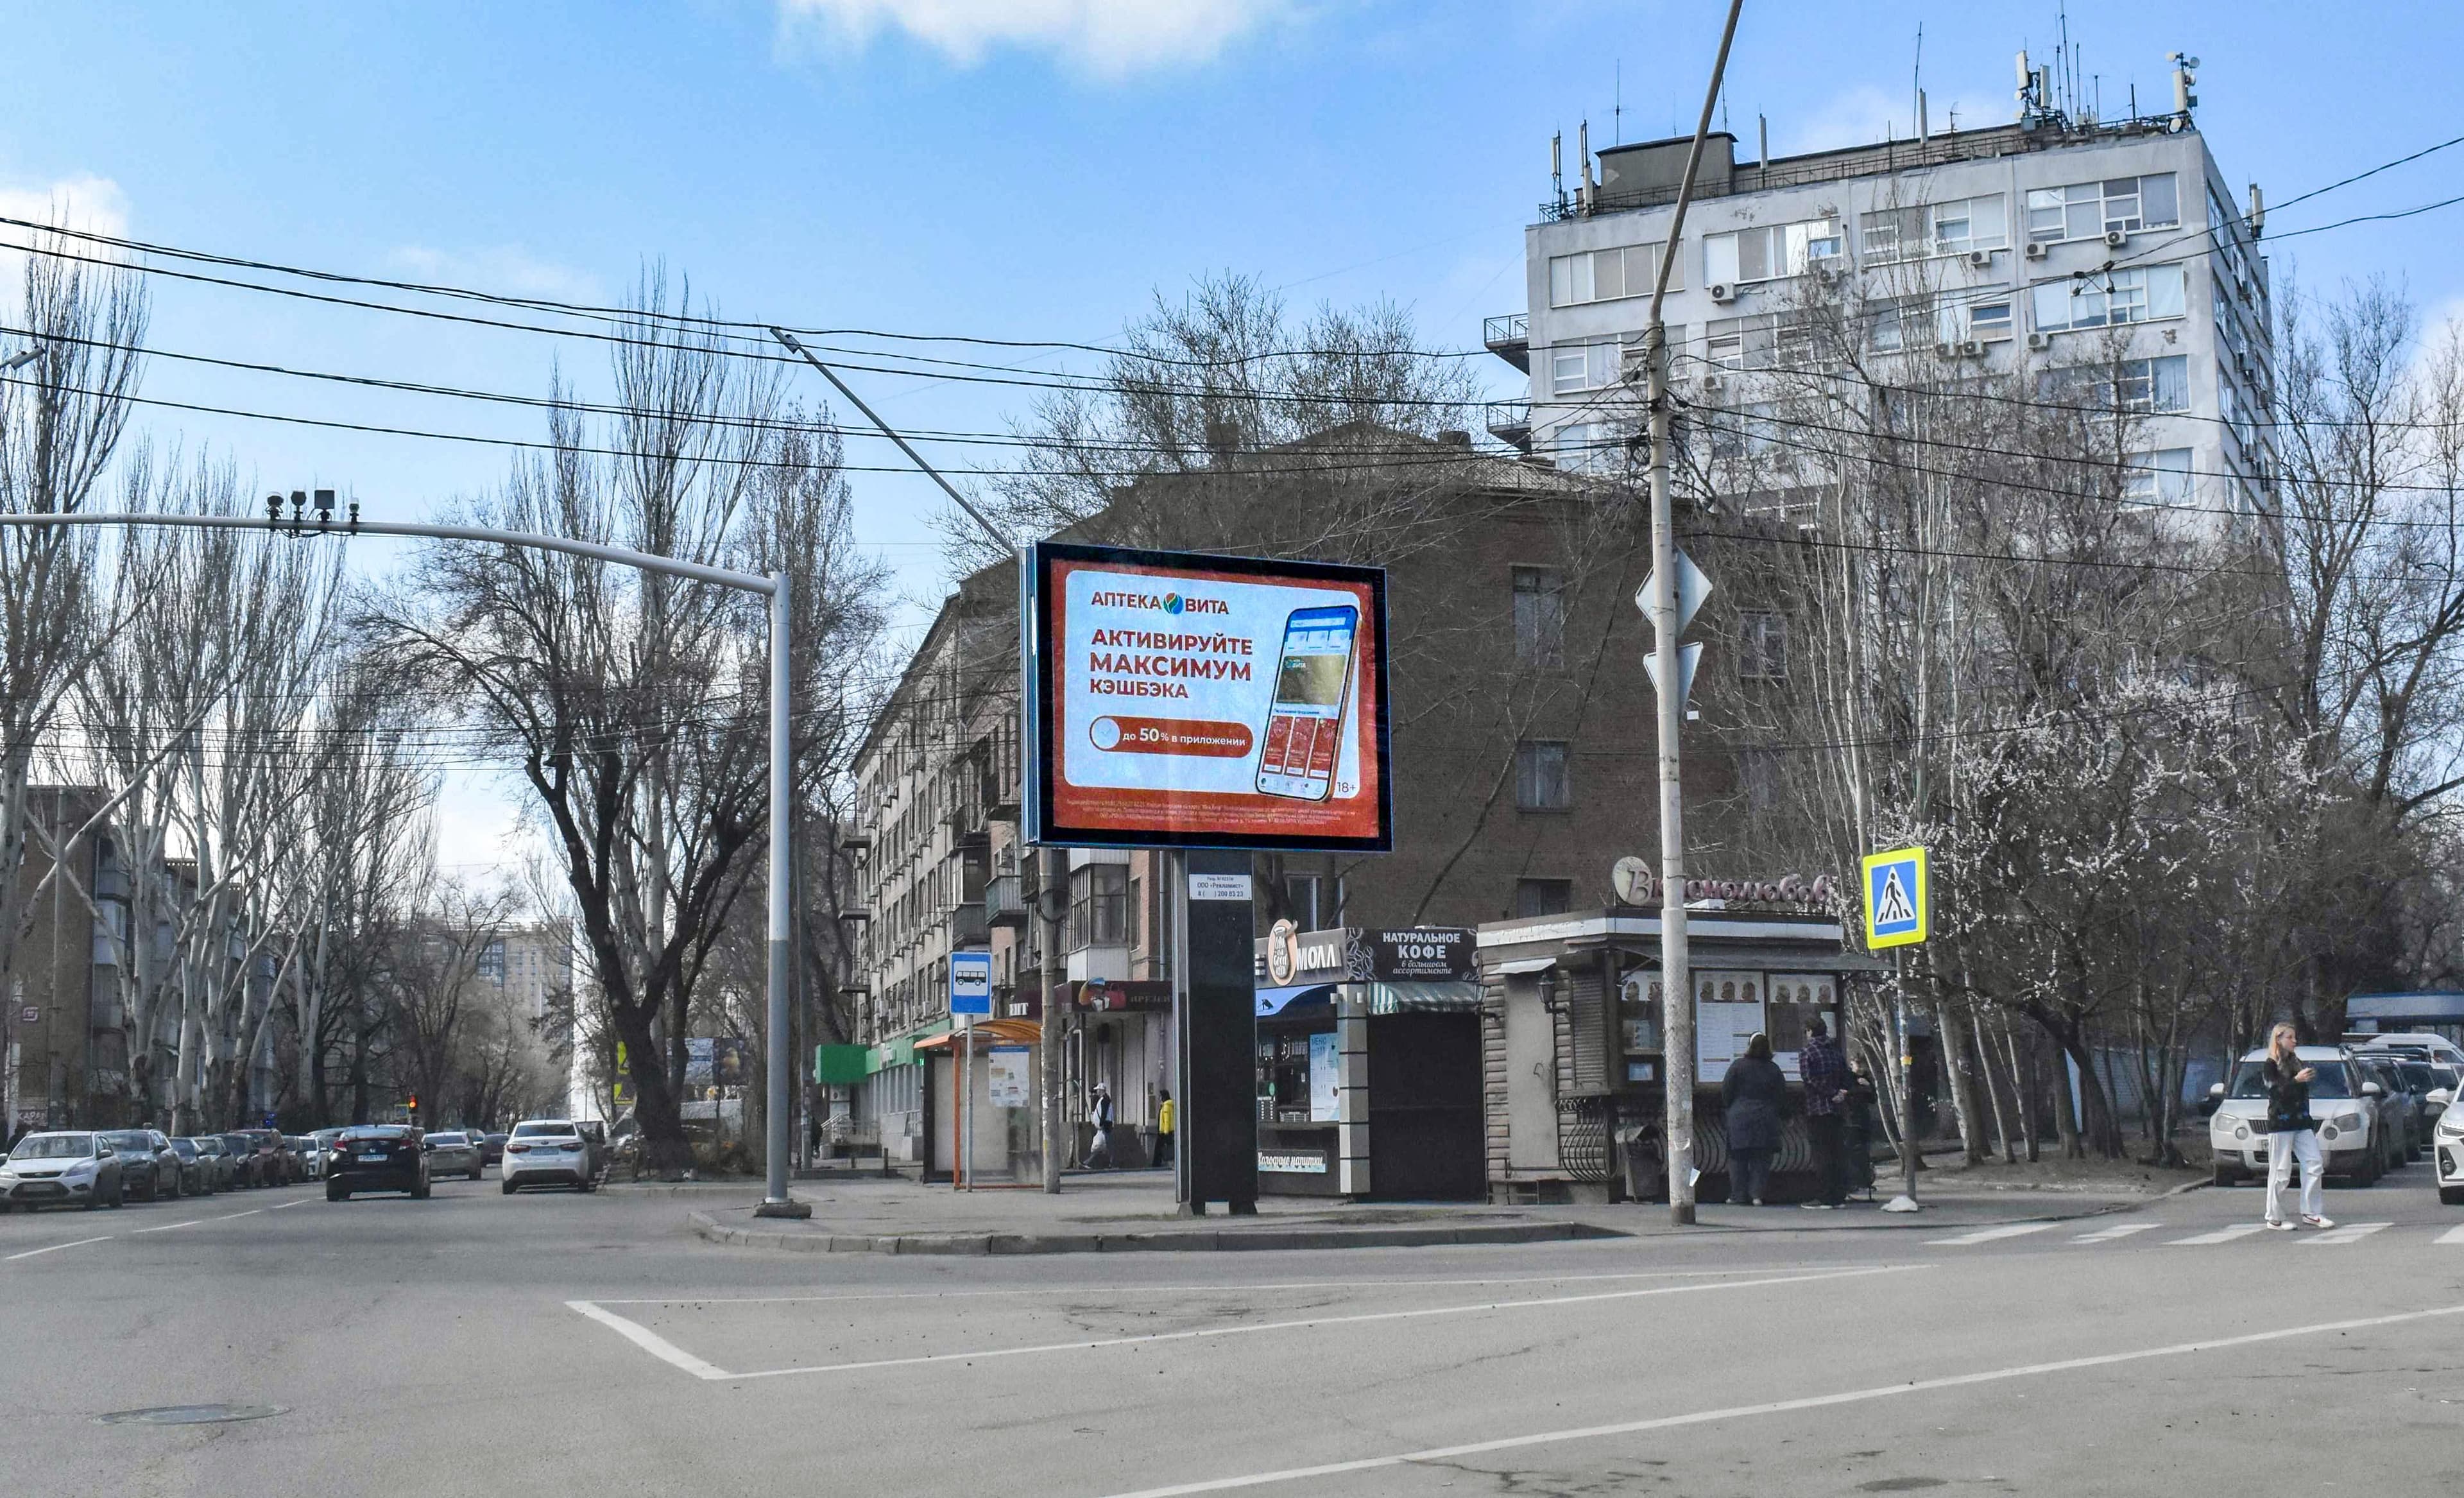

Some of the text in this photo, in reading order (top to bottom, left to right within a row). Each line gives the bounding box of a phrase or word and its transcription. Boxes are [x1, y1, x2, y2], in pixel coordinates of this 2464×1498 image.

[1091, 591, 1229, 614] АПТЕКА ВИТА
[1091, 629, 1253, 655] АКТИВИРУЙТЕ
[1090, 652, 1251, 681] МАКСИМУМ
[1090, 678, 1189, 698] КЭШБЭКА
[1123, 733, 1136, 741] до
[1180, 737, 1245, 746] приложении
[1337, 782, 1356, 793] 18+
[1383, 933, 1460, 943] НАТУРАЛЬНОЕ
[1296, 944, 1340, 971] МОЛЛ
[1398, 945, 1446, 959] КОФЕ
[1392, 968, 1452, 977] ассортименте
[1290, 1155, 1323, 1166] напитки
